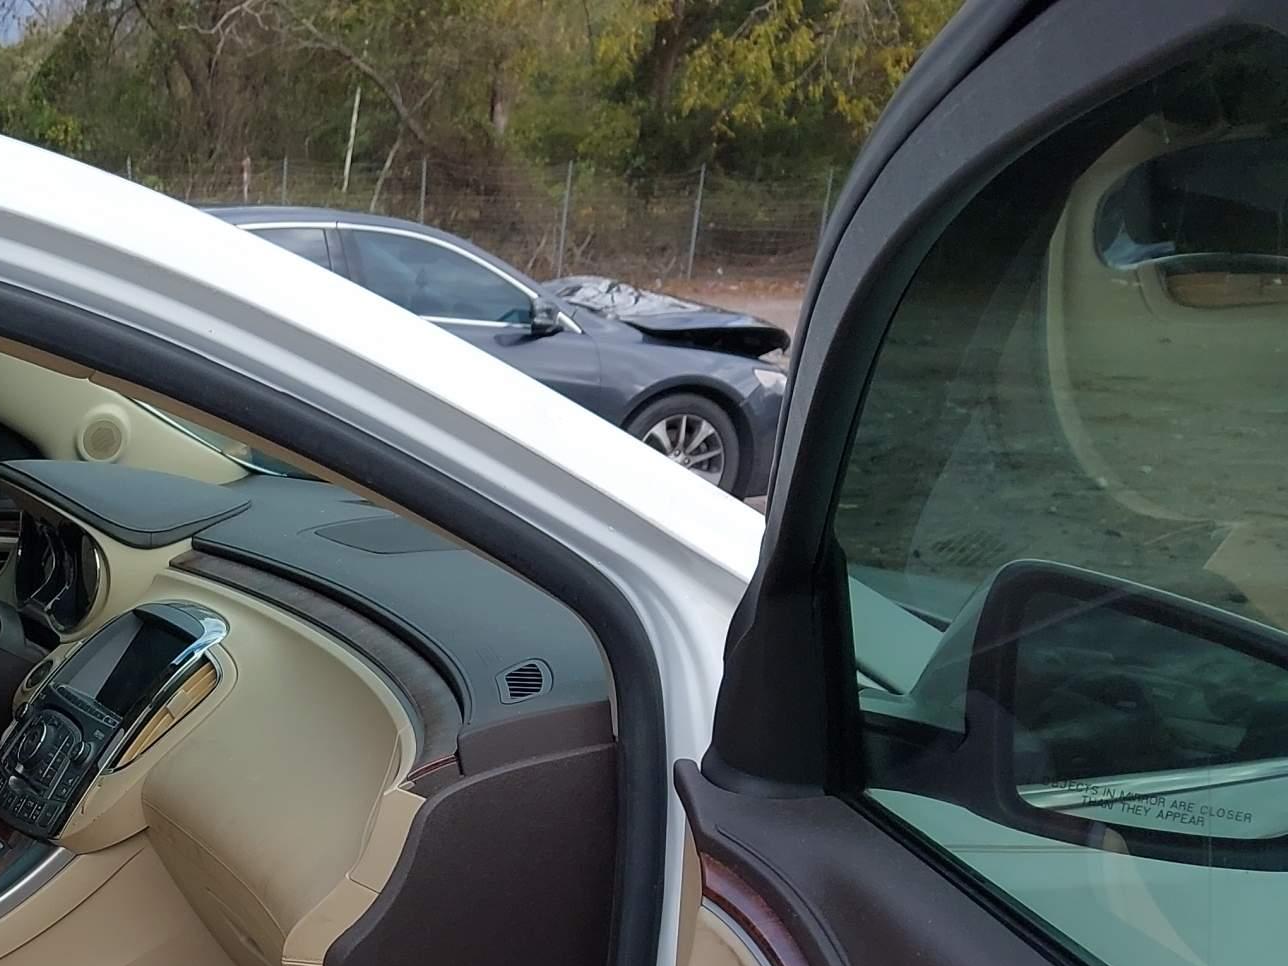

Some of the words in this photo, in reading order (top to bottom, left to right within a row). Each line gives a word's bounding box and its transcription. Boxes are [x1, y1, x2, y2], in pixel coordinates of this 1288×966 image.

[1103, 787, 1115, 799] IN
[1170, 799, 1194, 813] ARE
[1200, 805, 1253, 823] CLOSER
[1121, 801, 1151, 816] THEY
[1156, 809, 1205, 827] APPEAR
